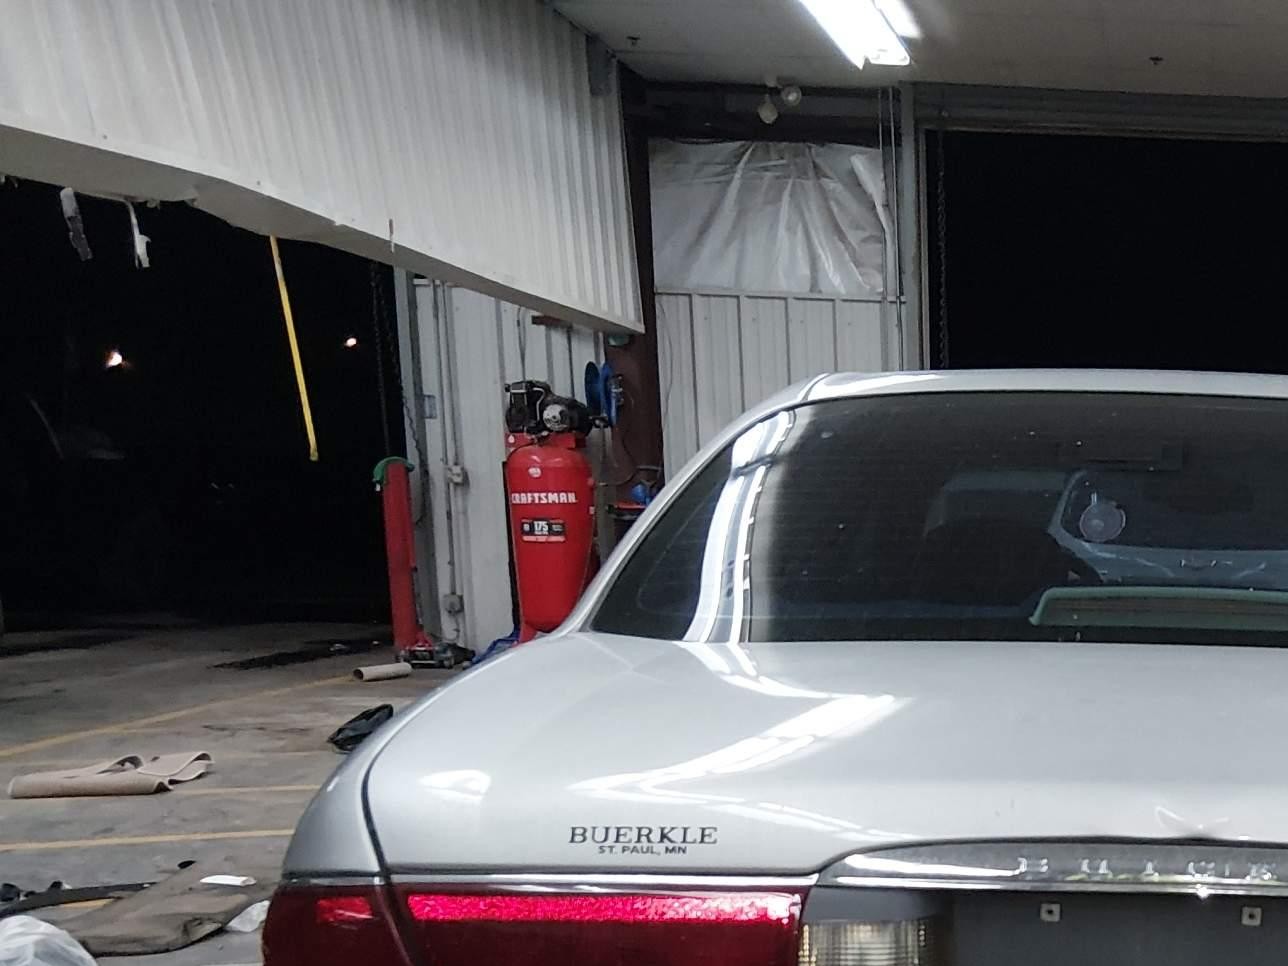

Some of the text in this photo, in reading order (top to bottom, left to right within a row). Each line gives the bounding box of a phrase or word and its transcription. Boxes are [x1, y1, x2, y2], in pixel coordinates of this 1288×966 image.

[511, 492, 577, 504] CRAFTSMAN
[568, 826, 718, 844] BUERKLE
[598, 845, 688, 856] ST. PAUL, MN
